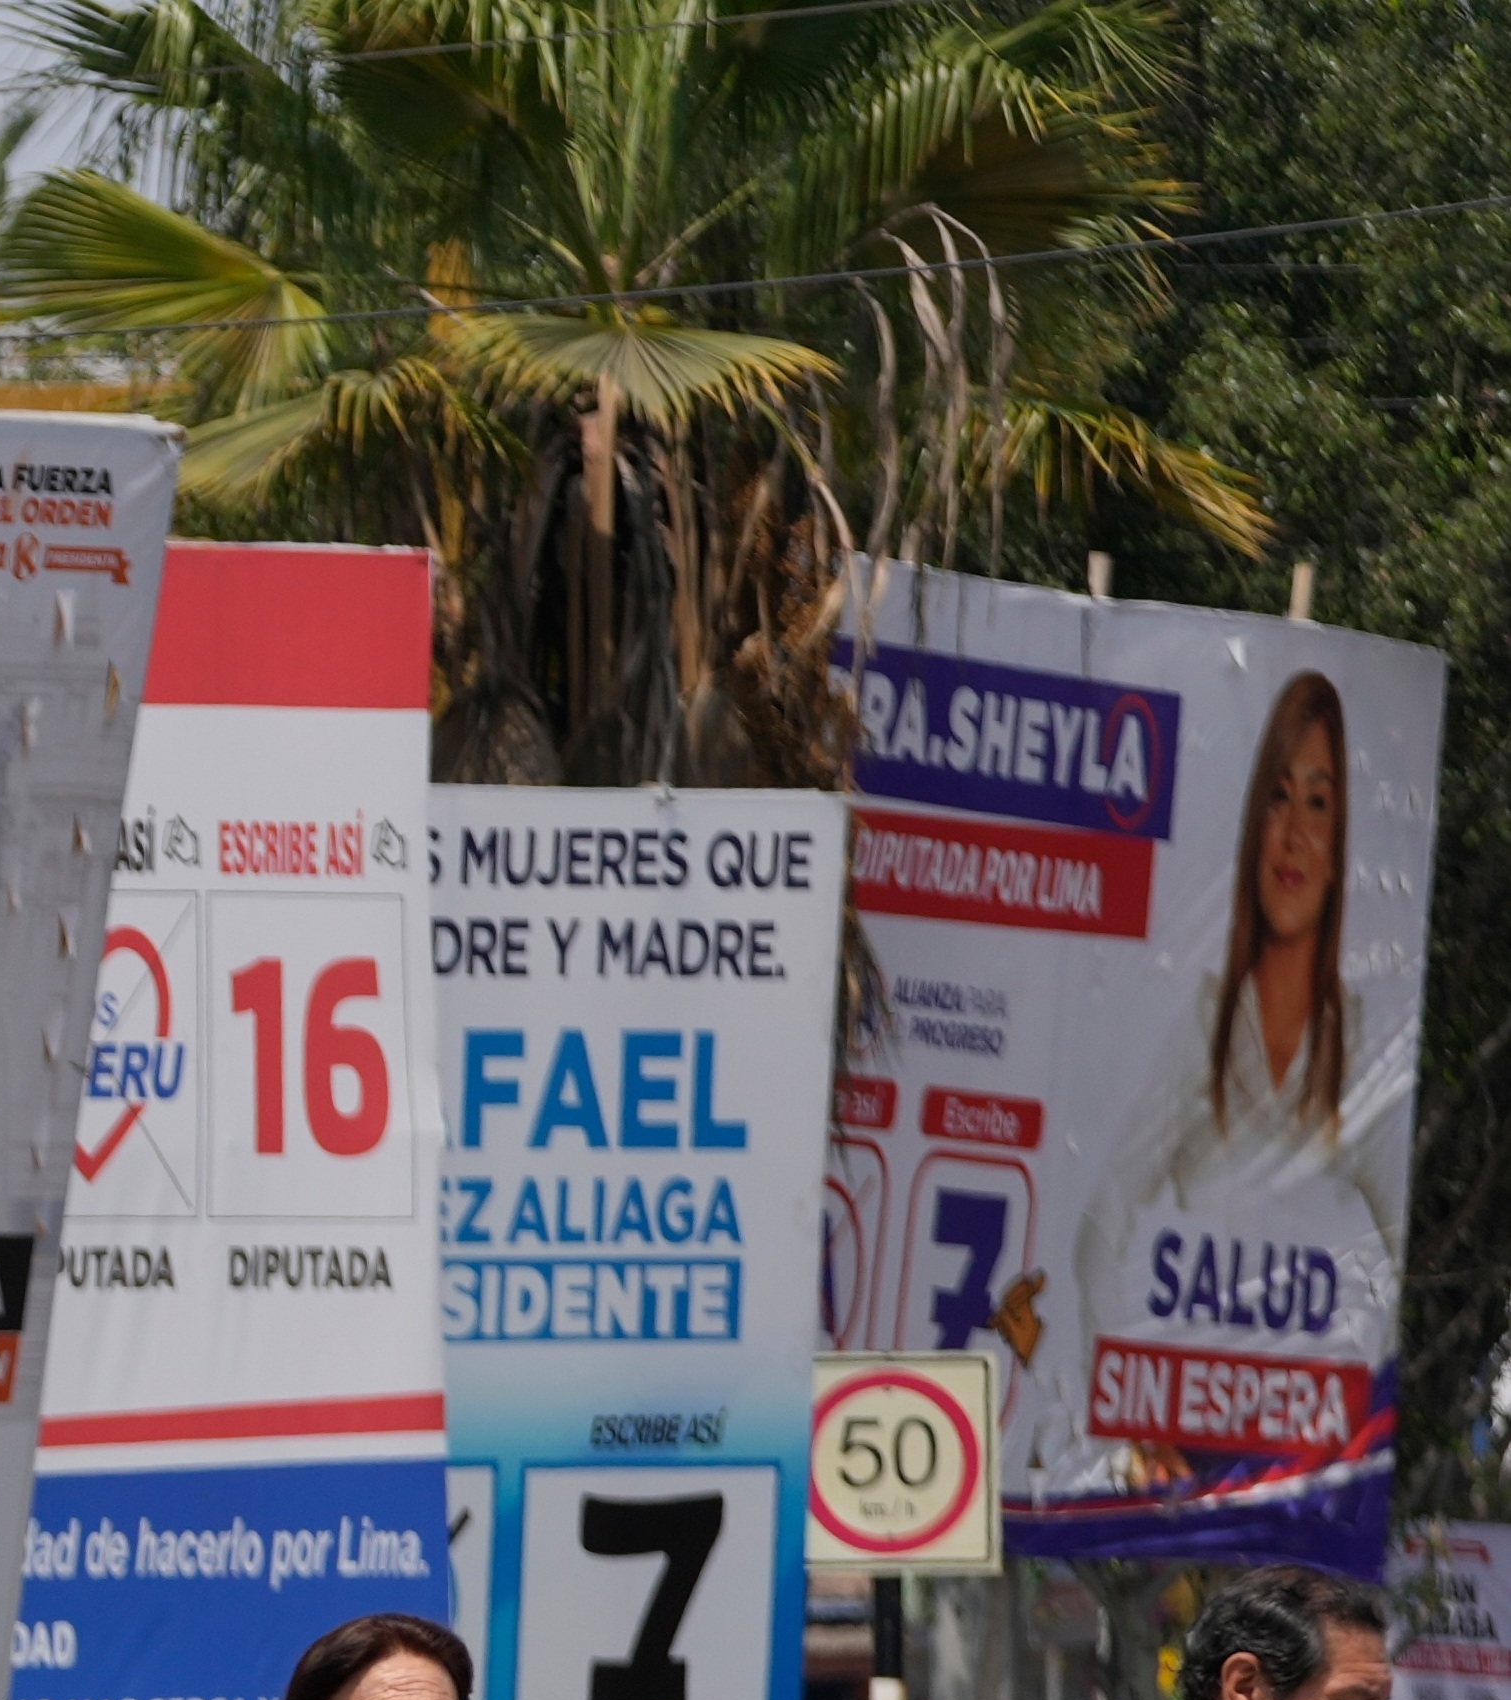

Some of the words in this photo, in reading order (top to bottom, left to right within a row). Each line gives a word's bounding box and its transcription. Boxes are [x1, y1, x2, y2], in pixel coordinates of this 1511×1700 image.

[12, 463, 112, 495] FUERZA
[21, 497, 112, 528] ORDEN
[218, 819, 319, 877] ESCRIBE
[325, 808, 366, 877] ASÍ
[460, 826, 691, 890] MUJERES
[707, 829, 816, 890] QUE
[853, 829, 979, 899] DIPUTADA
[979, 846, 1037, 908] POR
[1038, 854, 1103, 919] LIMA
[549, 916, 580, 977] Y
[597, 919, 787, 980] MADRE.
[84, 1040, 187, 1101] ERU
[229, 955, 392, 1157] 16
[445, 1026, 750, 1151] FAEL
[941, 1094, 1022, 1140] Escribe
[505, 1178, 744, 1246] ALIAGA
[227, 1246, 393, 1291] DIPUTADA
[932, 1187, 1009, 1350] 7
[1146, 1228, 1338, 1333] SALUD
[589, 1413, 684, 1446] ESCRIBE
[686, 1405, 730, 1446] ASÍ
[1095, 1350, 1174, 1427] SIN
[1177, 1359, 1352, 1447] ESPERA
[838, 1414, 938, 1490] 50
[84, 1515, 131, 1581] de
[135, 1515, 266, 1581] hacerlo
[269, 1528, 334, 1593] por
[336, 1515, 431, 1580] Lima.
